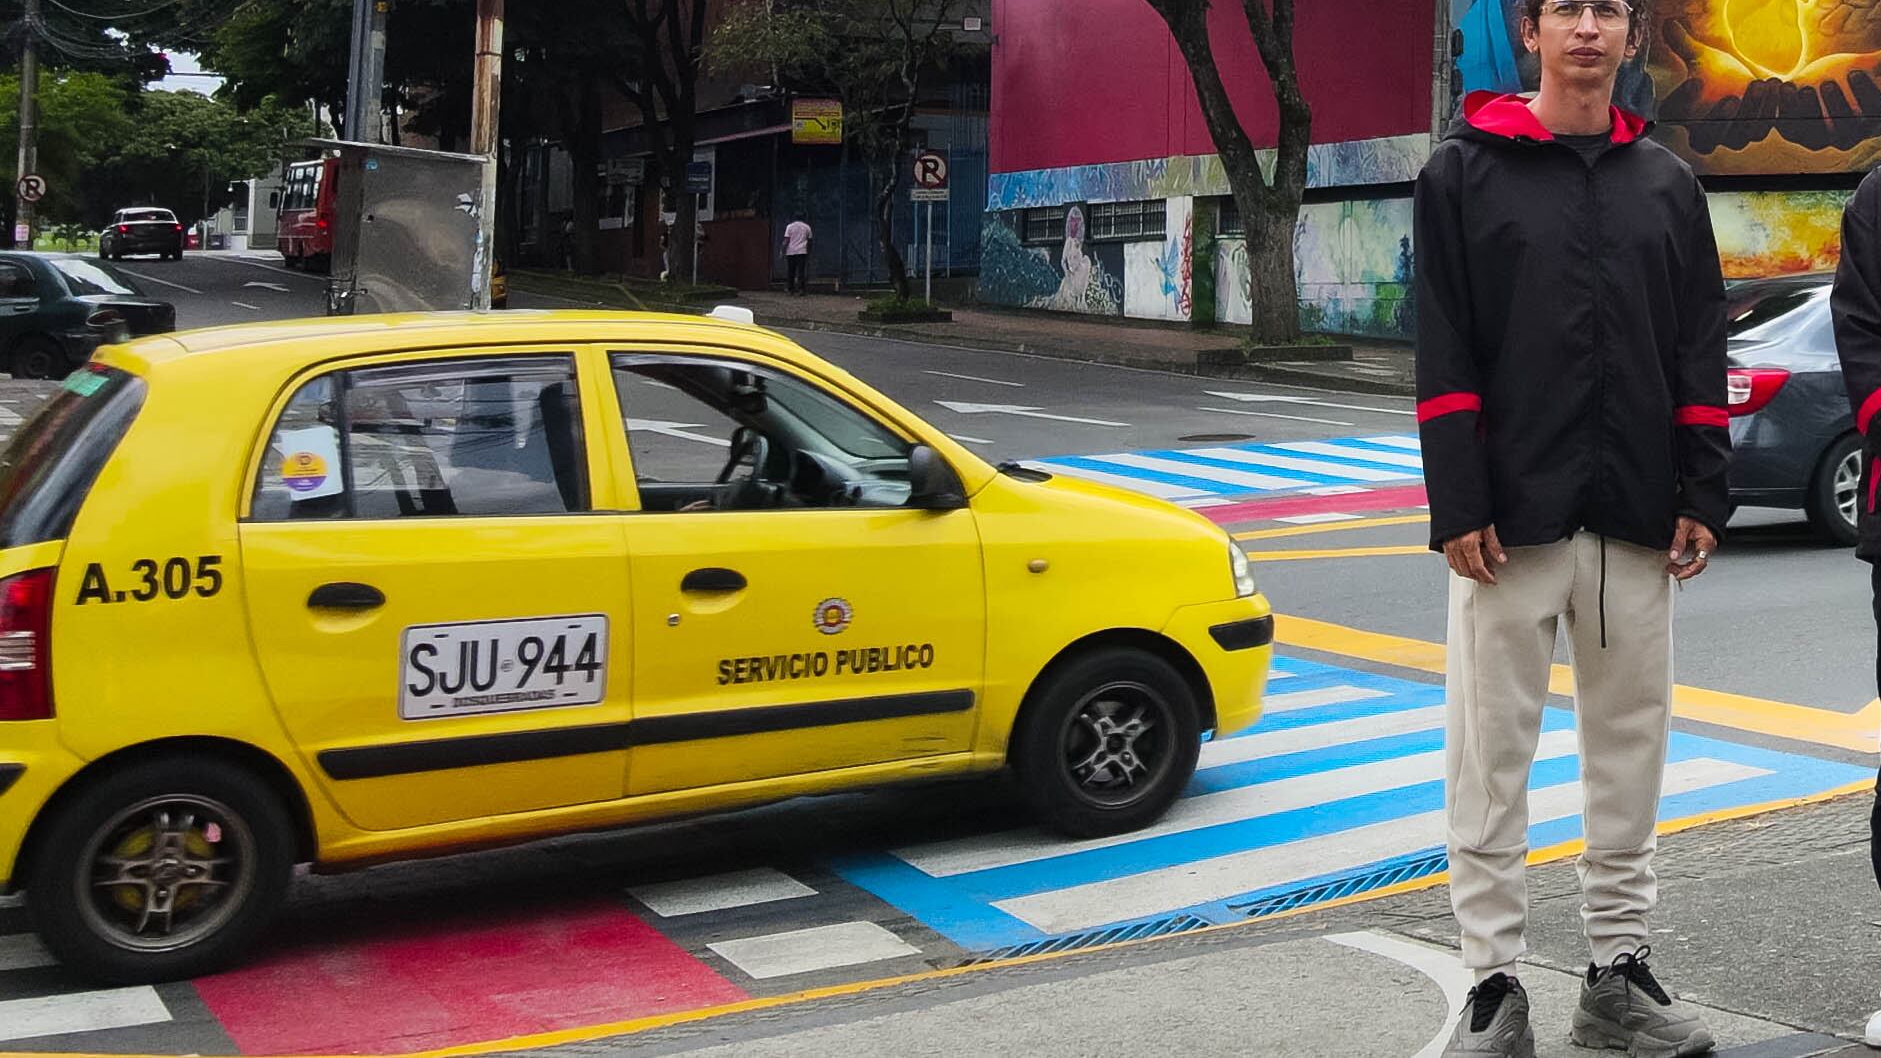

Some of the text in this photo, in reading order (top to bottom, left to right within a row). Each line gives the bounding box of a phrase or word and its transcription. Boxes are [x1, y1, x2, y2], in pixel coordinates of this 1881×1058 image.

[74, 555, 223, 606] A.305
[408, 632, 602, 697] SJU 944
[717, 643, 934, 685] SERVICIO PUBLICO
